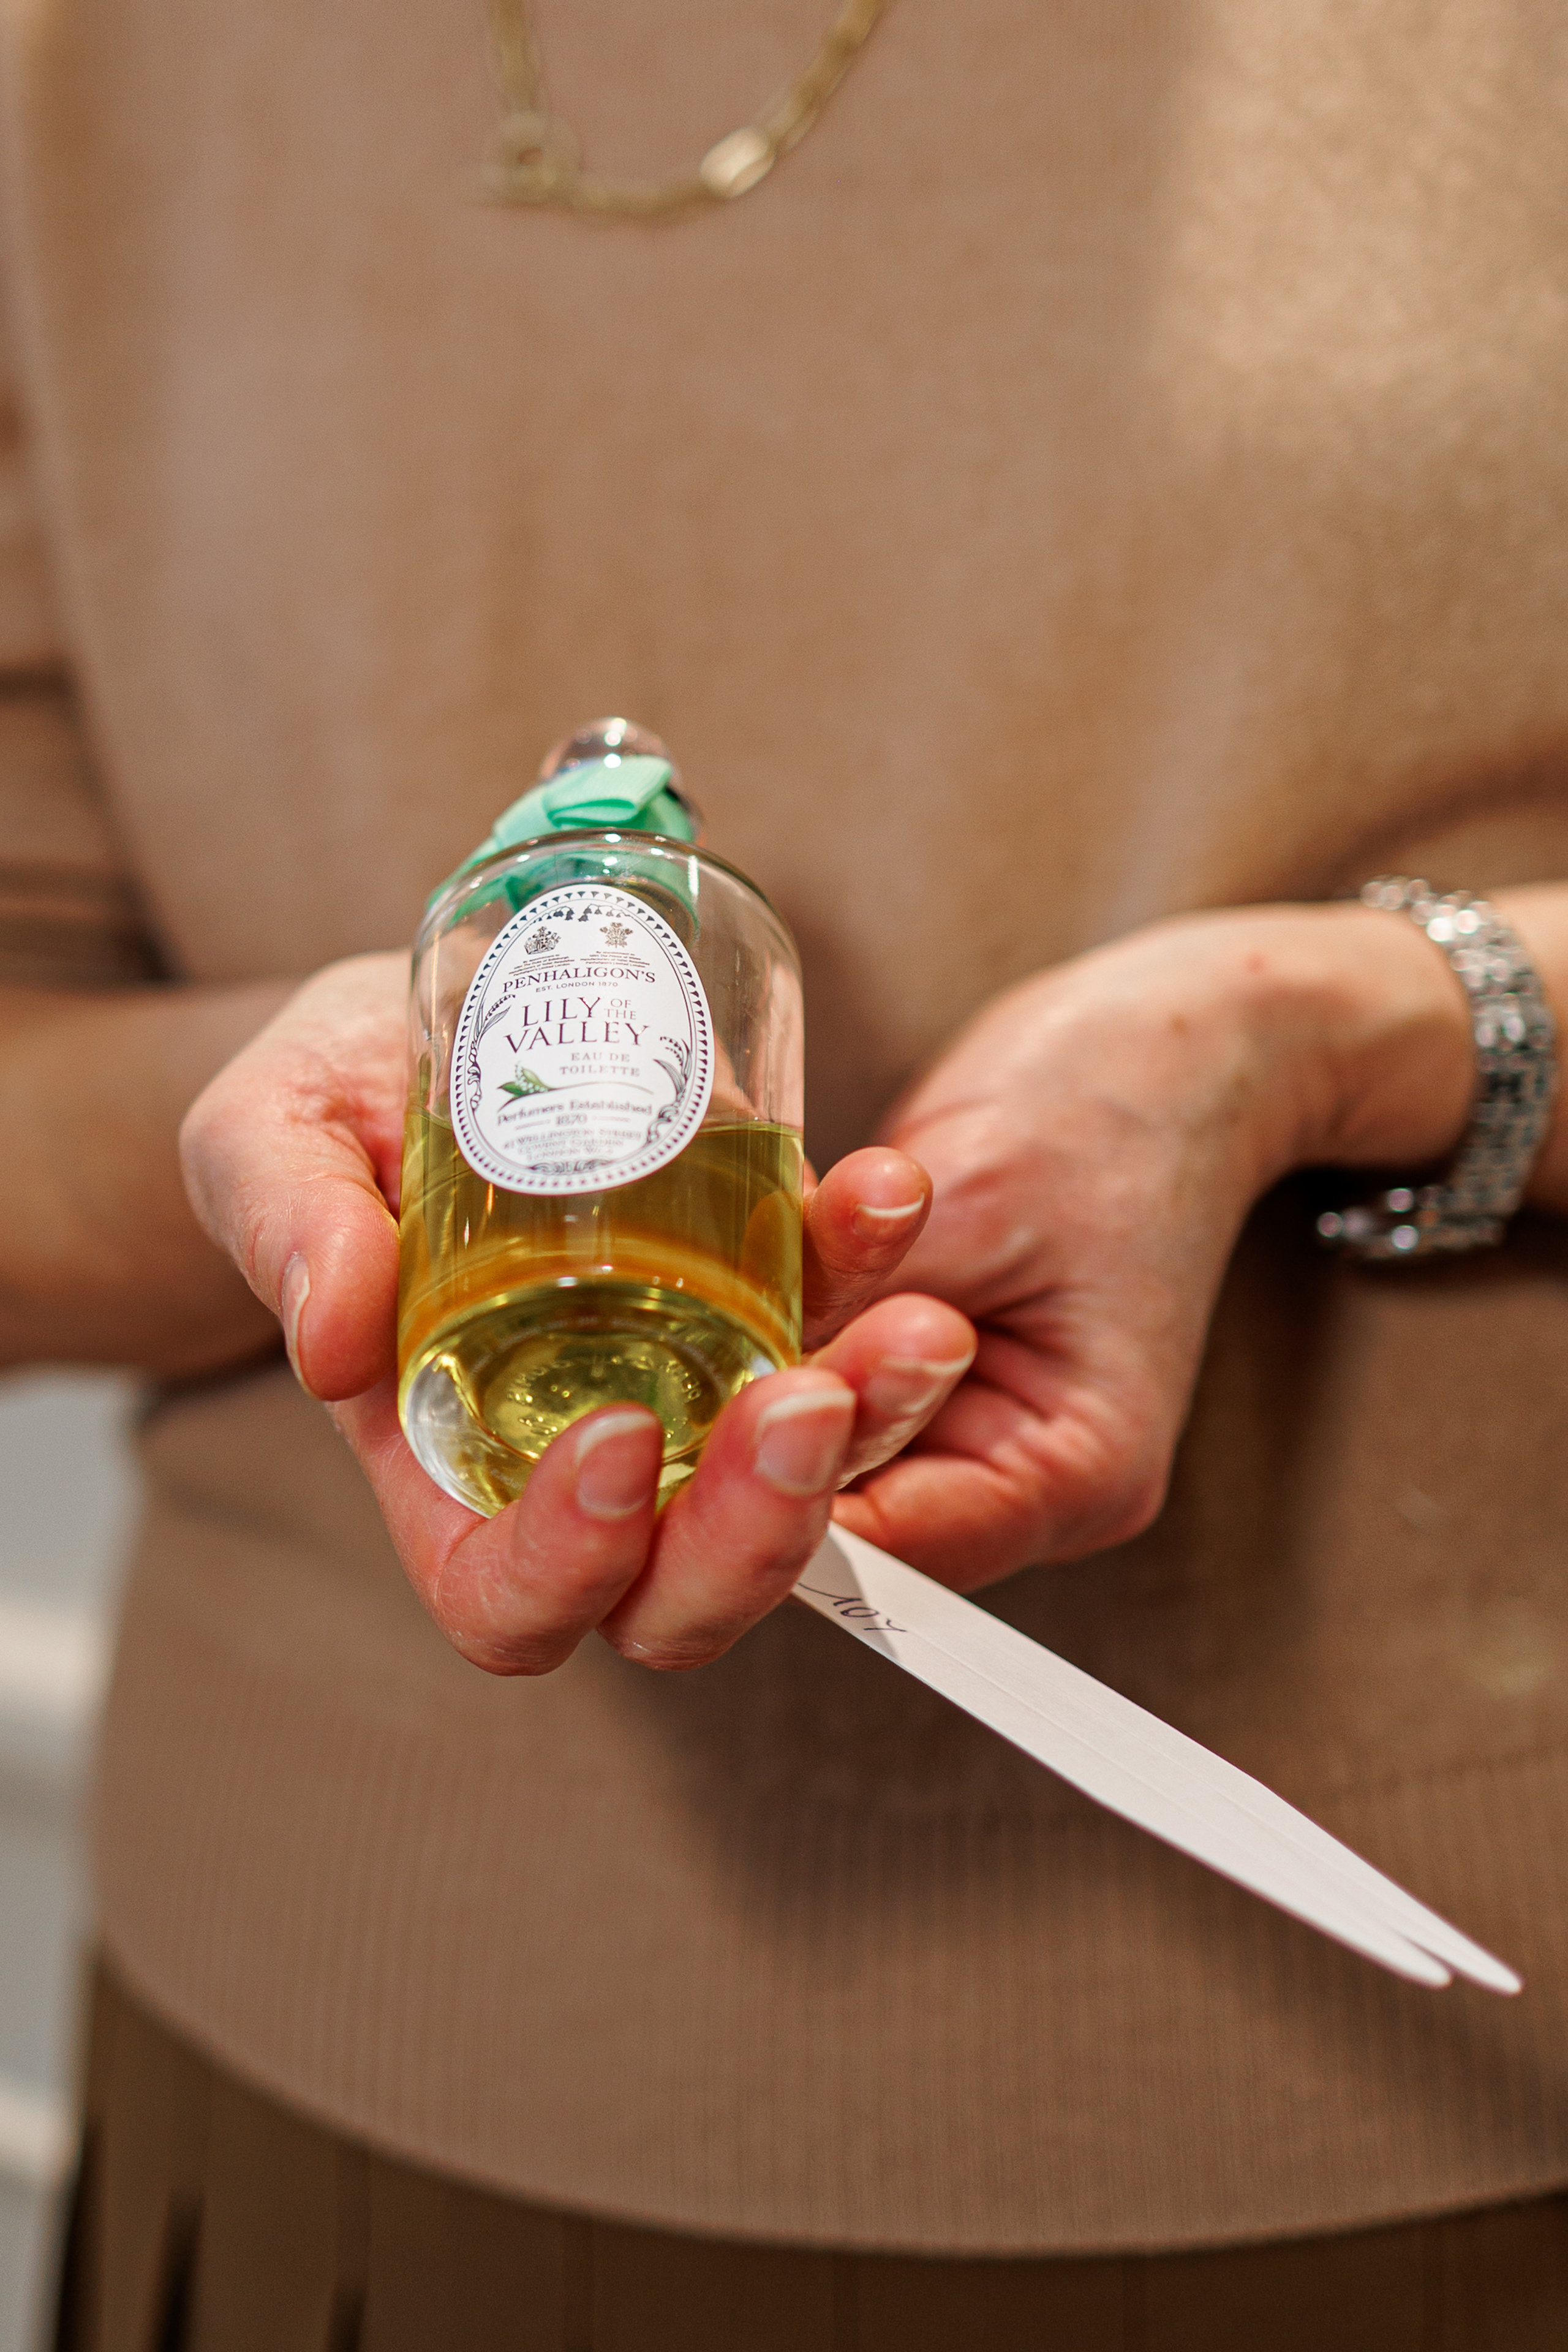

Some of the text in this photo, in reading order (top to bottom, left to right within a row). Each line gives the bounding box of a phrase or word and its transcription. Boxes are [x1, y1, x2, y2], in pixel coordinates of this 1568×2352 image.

[503, 967, 655, 993] PENHALIGON'S
[522, 997, 601, 1027] LILY
[611, 998, 631, 1008] OF
[604, 1008, 636, 1020] THE
[503, 1021, 649, 1054] VALLEY
[571, 1052, 630, 1063] EAU DE
[560, 1065, 640, 1077] TOILETTE
[497, 1099, 653, 1126] Perfumers Established
